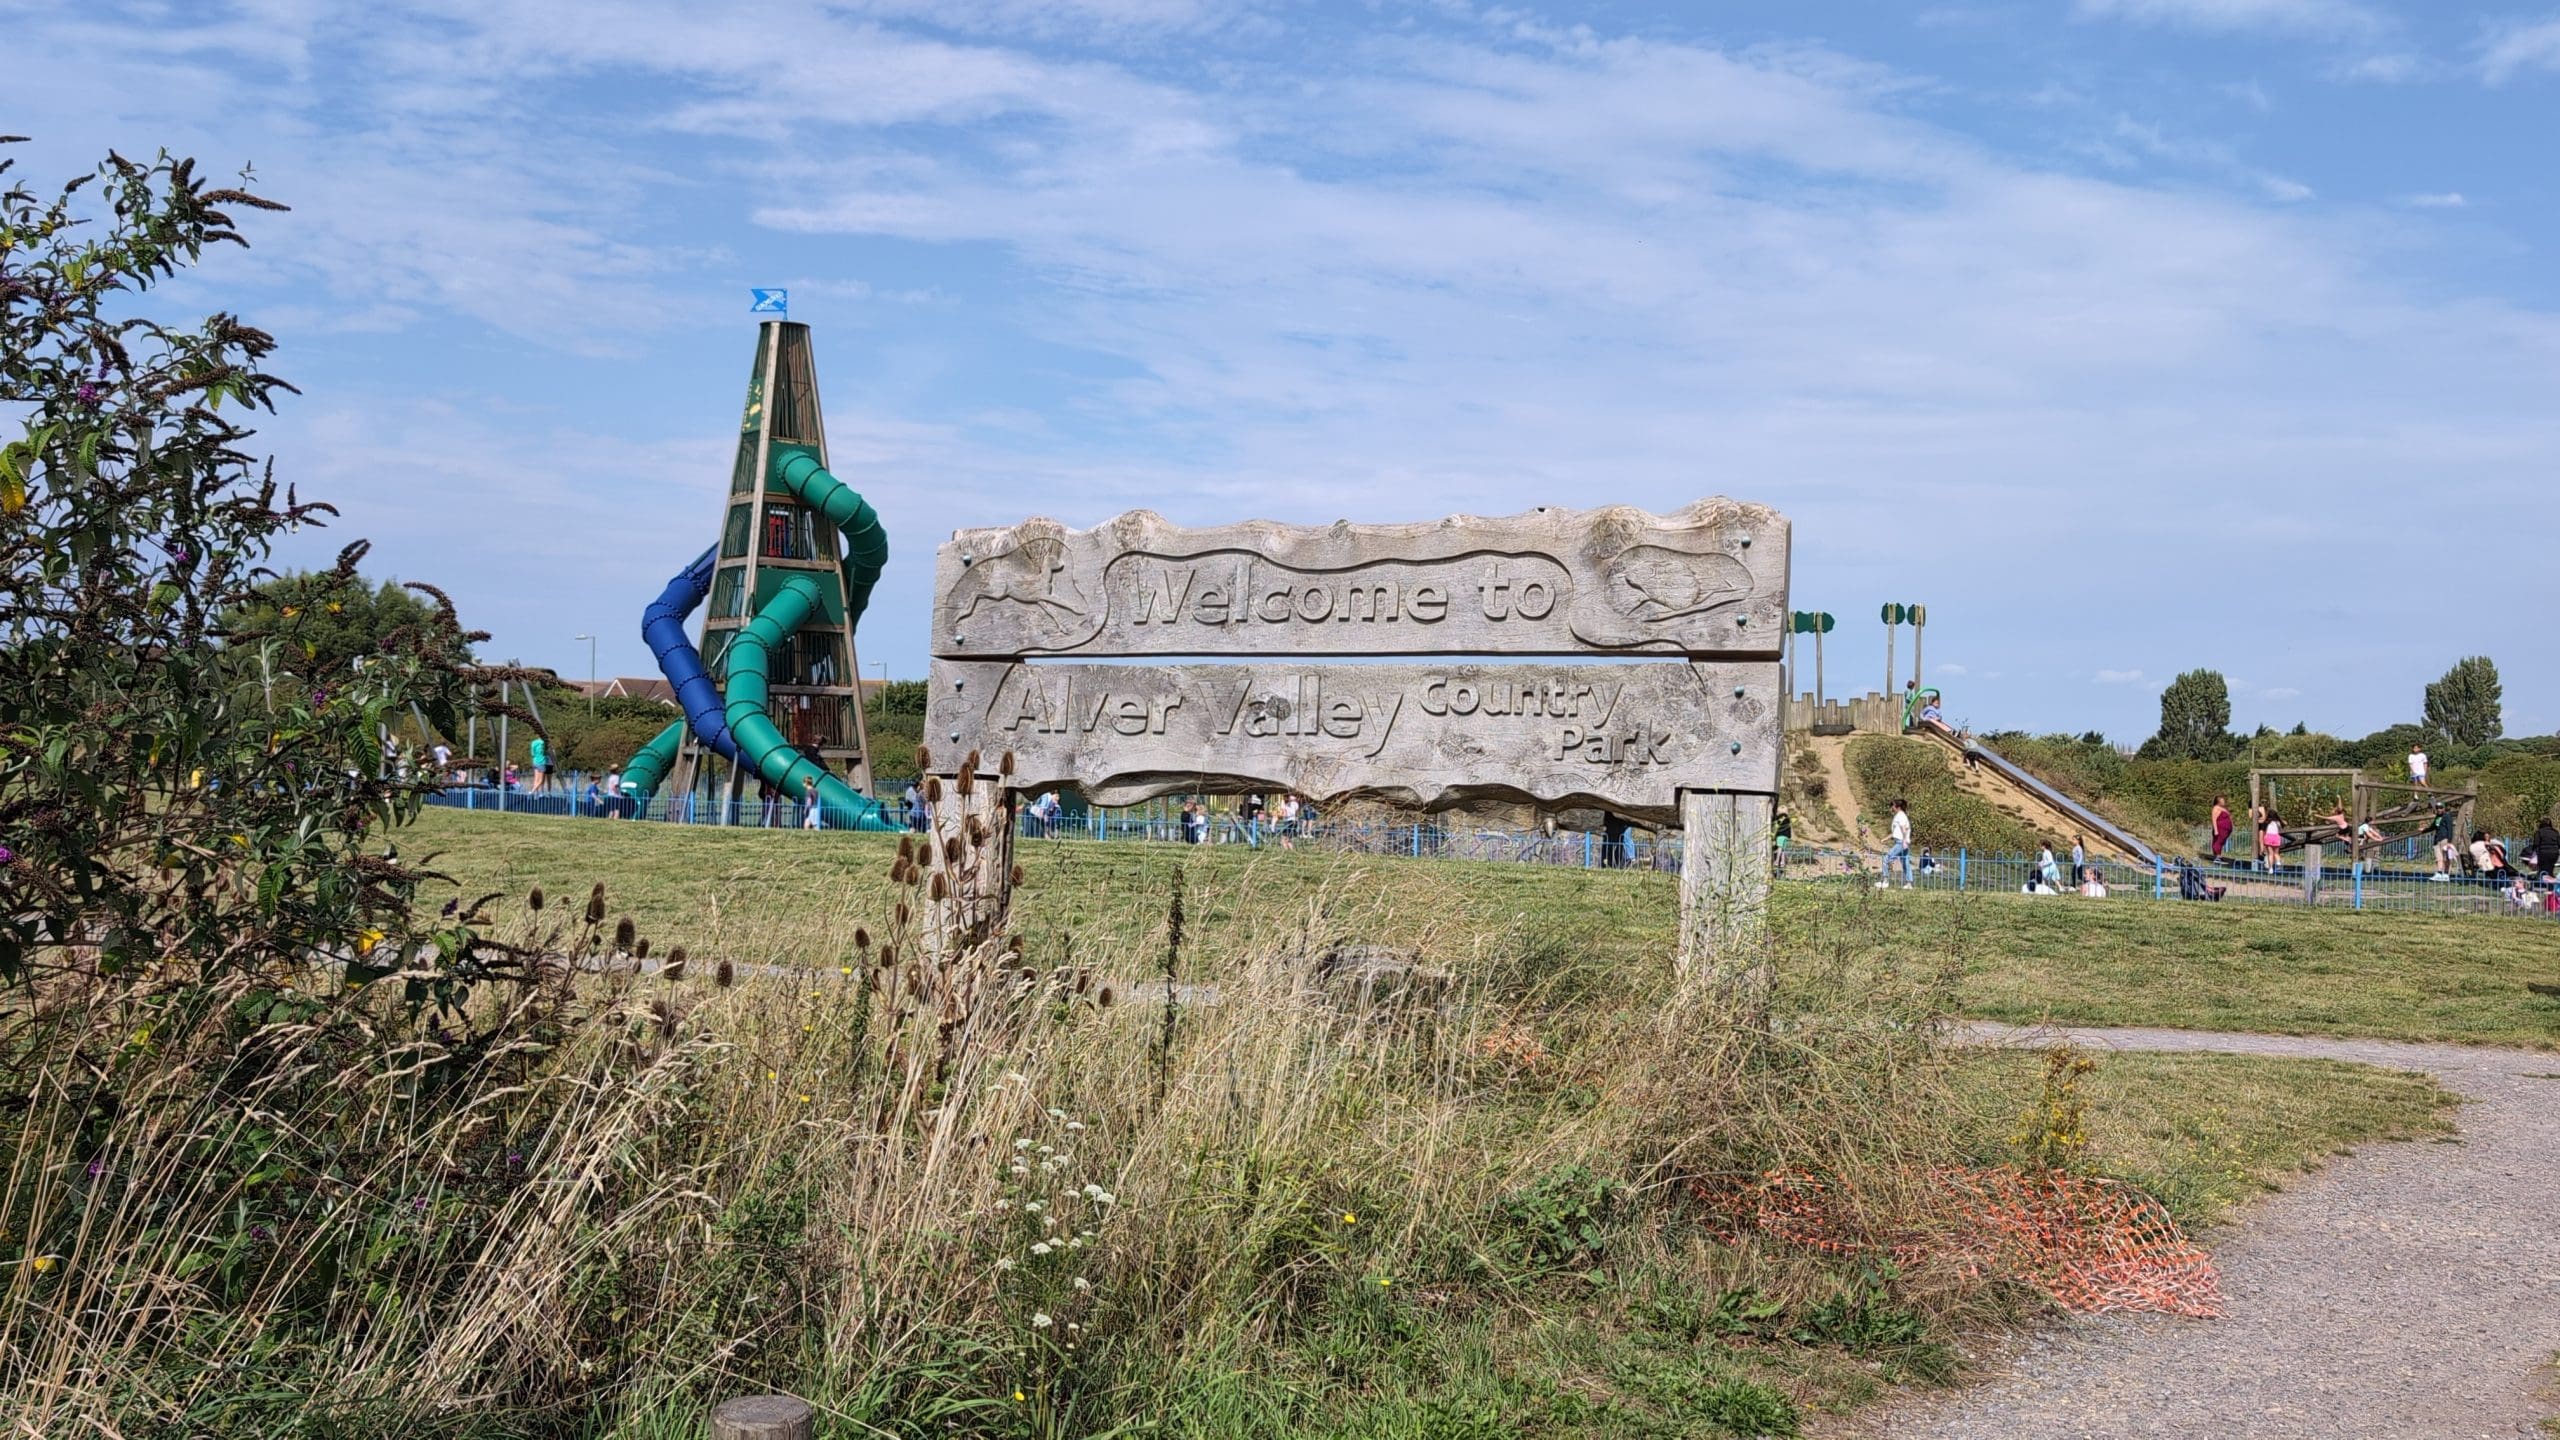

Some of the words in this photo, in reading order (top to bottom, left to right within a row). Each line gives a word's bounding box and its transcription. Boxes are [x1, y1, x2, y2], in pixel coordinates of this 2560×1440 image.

[1126, 560, 1449, 625] Welcome
[1477, 562, 1556, 622] to
[1004, 675, 1186, 737] Alver
[1197, 674, 1404, 759] Valley
[1419, 676, 1625, 729] Country
[1553, 720, 1672, 766] Park
